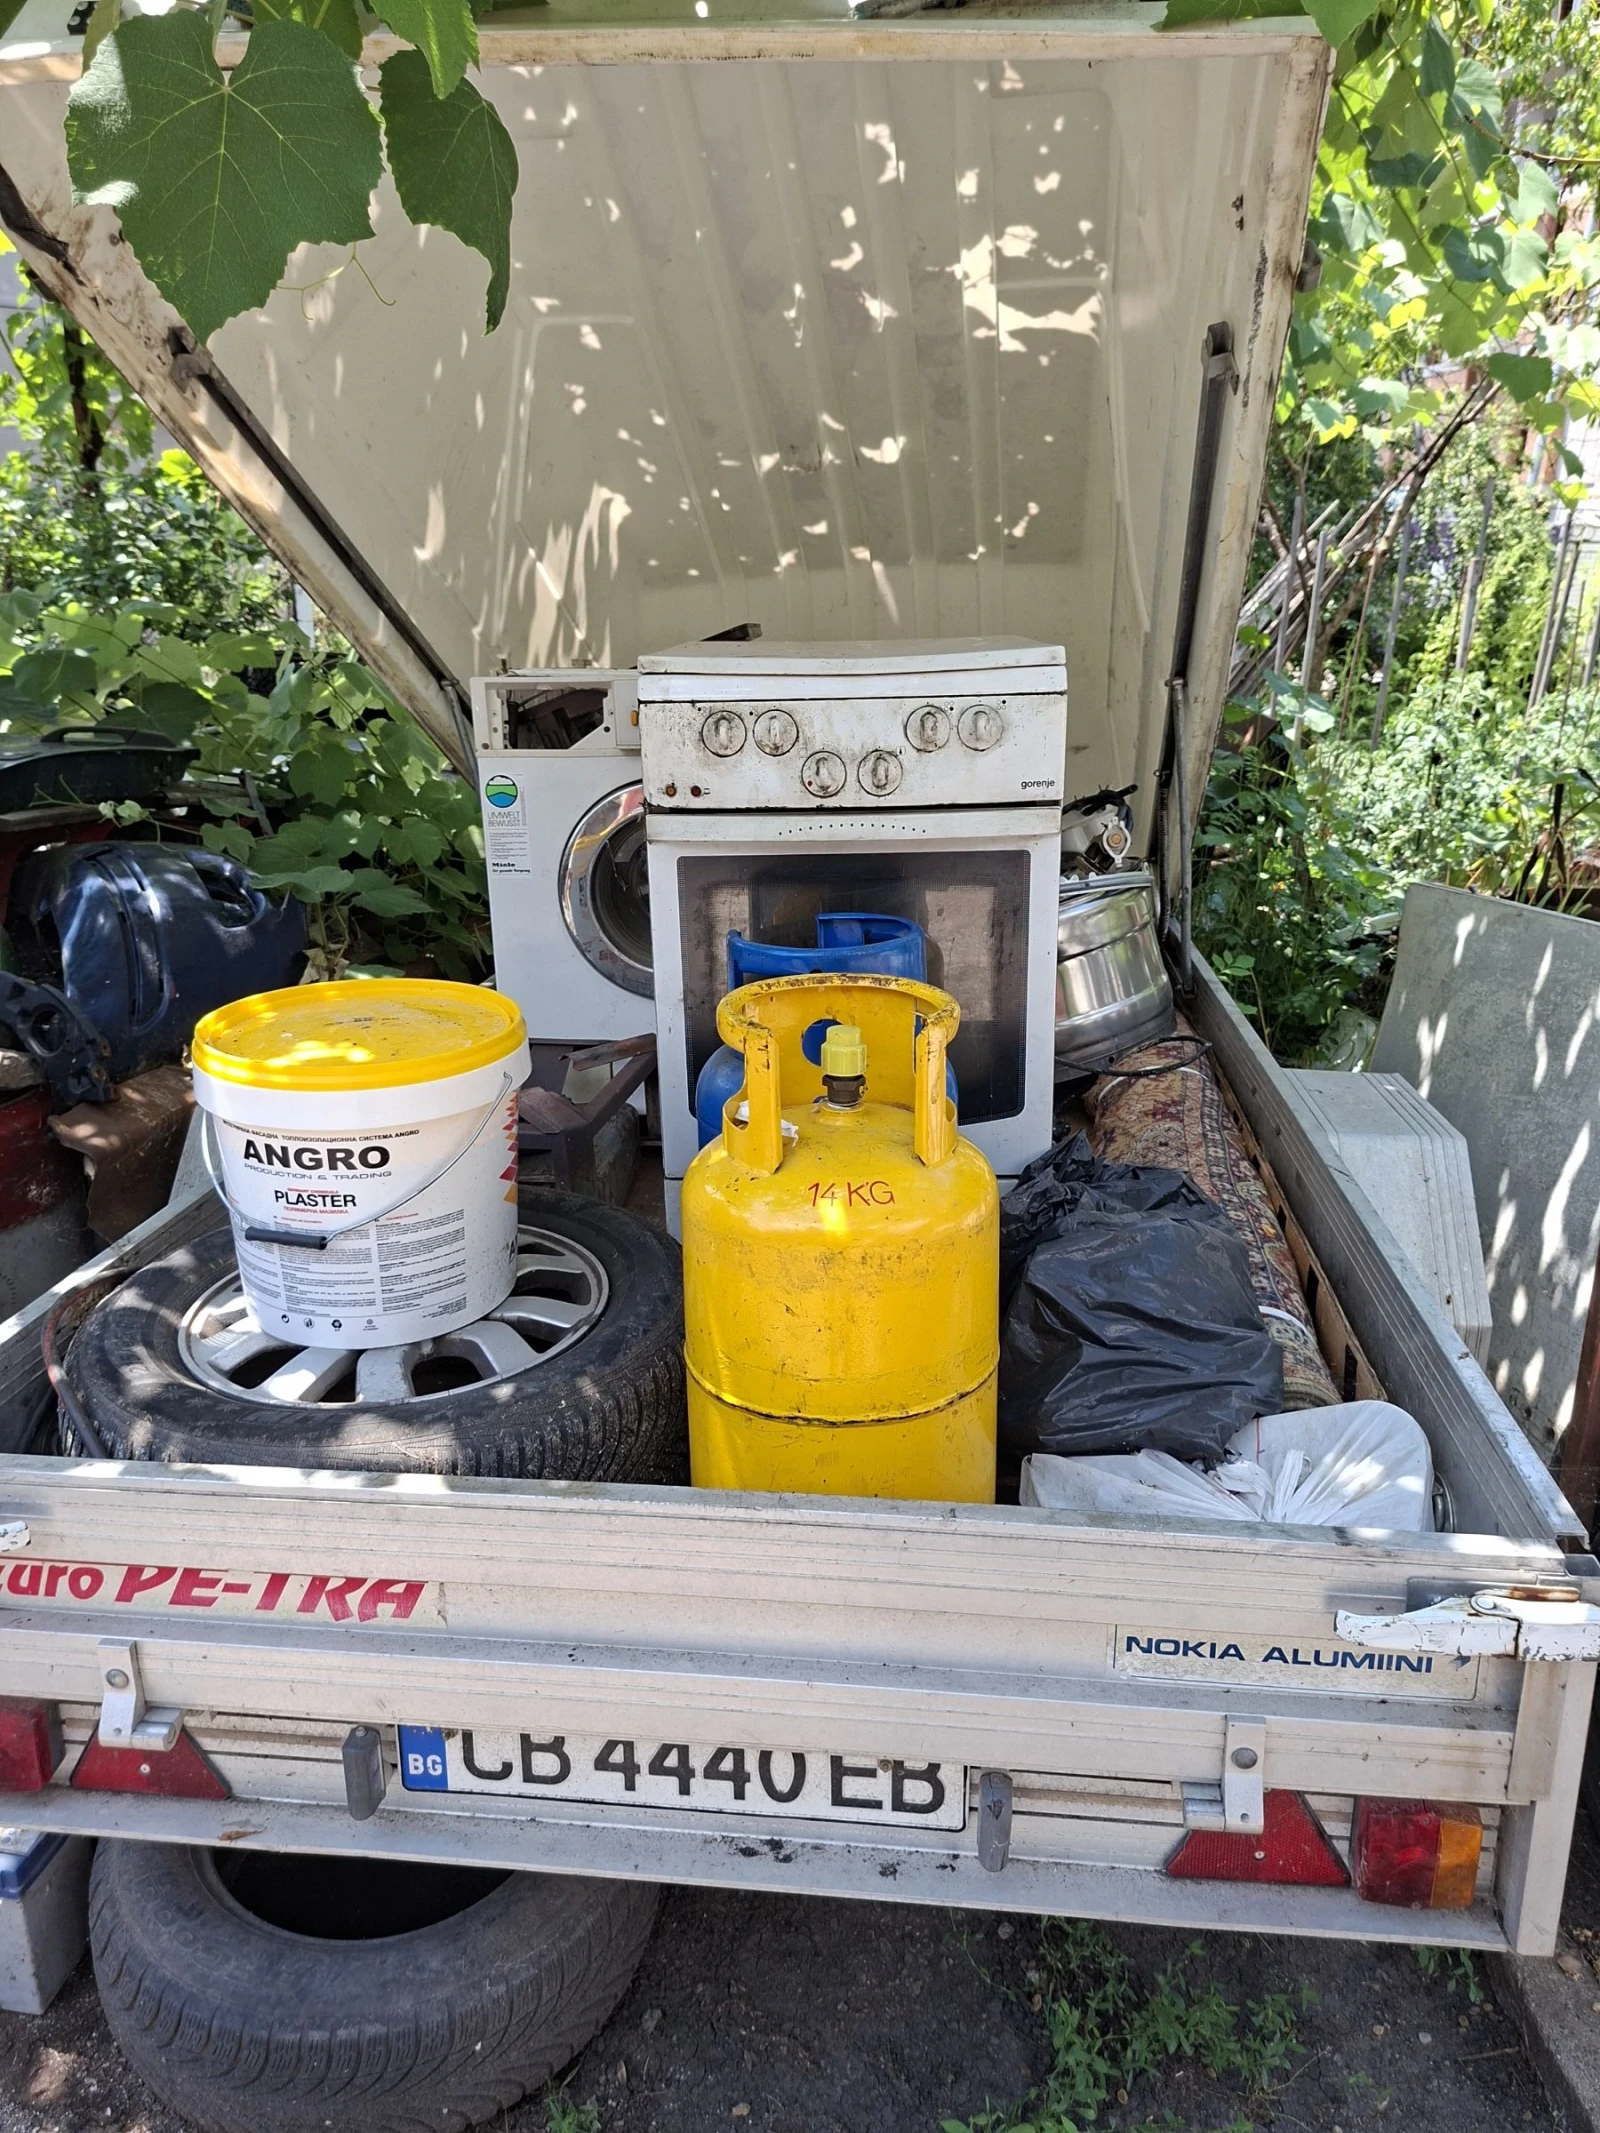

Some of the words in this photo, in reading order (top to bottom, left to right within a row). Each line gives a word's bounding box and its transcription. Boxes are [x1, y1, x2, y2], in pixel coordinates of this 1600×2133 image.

[1021, 778, 1056, 790] gorenje
[487, 811, 520, 820] UMWELT
[488, 819, 520, 827] BEWUSST
[358, 1132, 393, 1142] СИСТЕМА
[395, 1129, 420, 1138] ANGRO
[243, 1138, 391, 1171] ANGRO
[244, 1162, 312, 1180] PRODUCTION
[333, 1171, 392, 1180] TRADING
[274, 1189, 357, 1208] PLASTER
[807, 1182, 838, 1207] 14
[847, 1180, 896, 1207] KG
[0, 1564, 105, 1600] uro
[114, 1565, 427, 1622] PE-TRA
[1125, 1636, 1246, 1661] NOKIA
[1261, 1646, 1433, 1674] ALUMIINI
[408, 1752, 443, 1776] BG
[593, 1738, 807, 1803] 4440
[830, 1755, 946, 1814] EB
